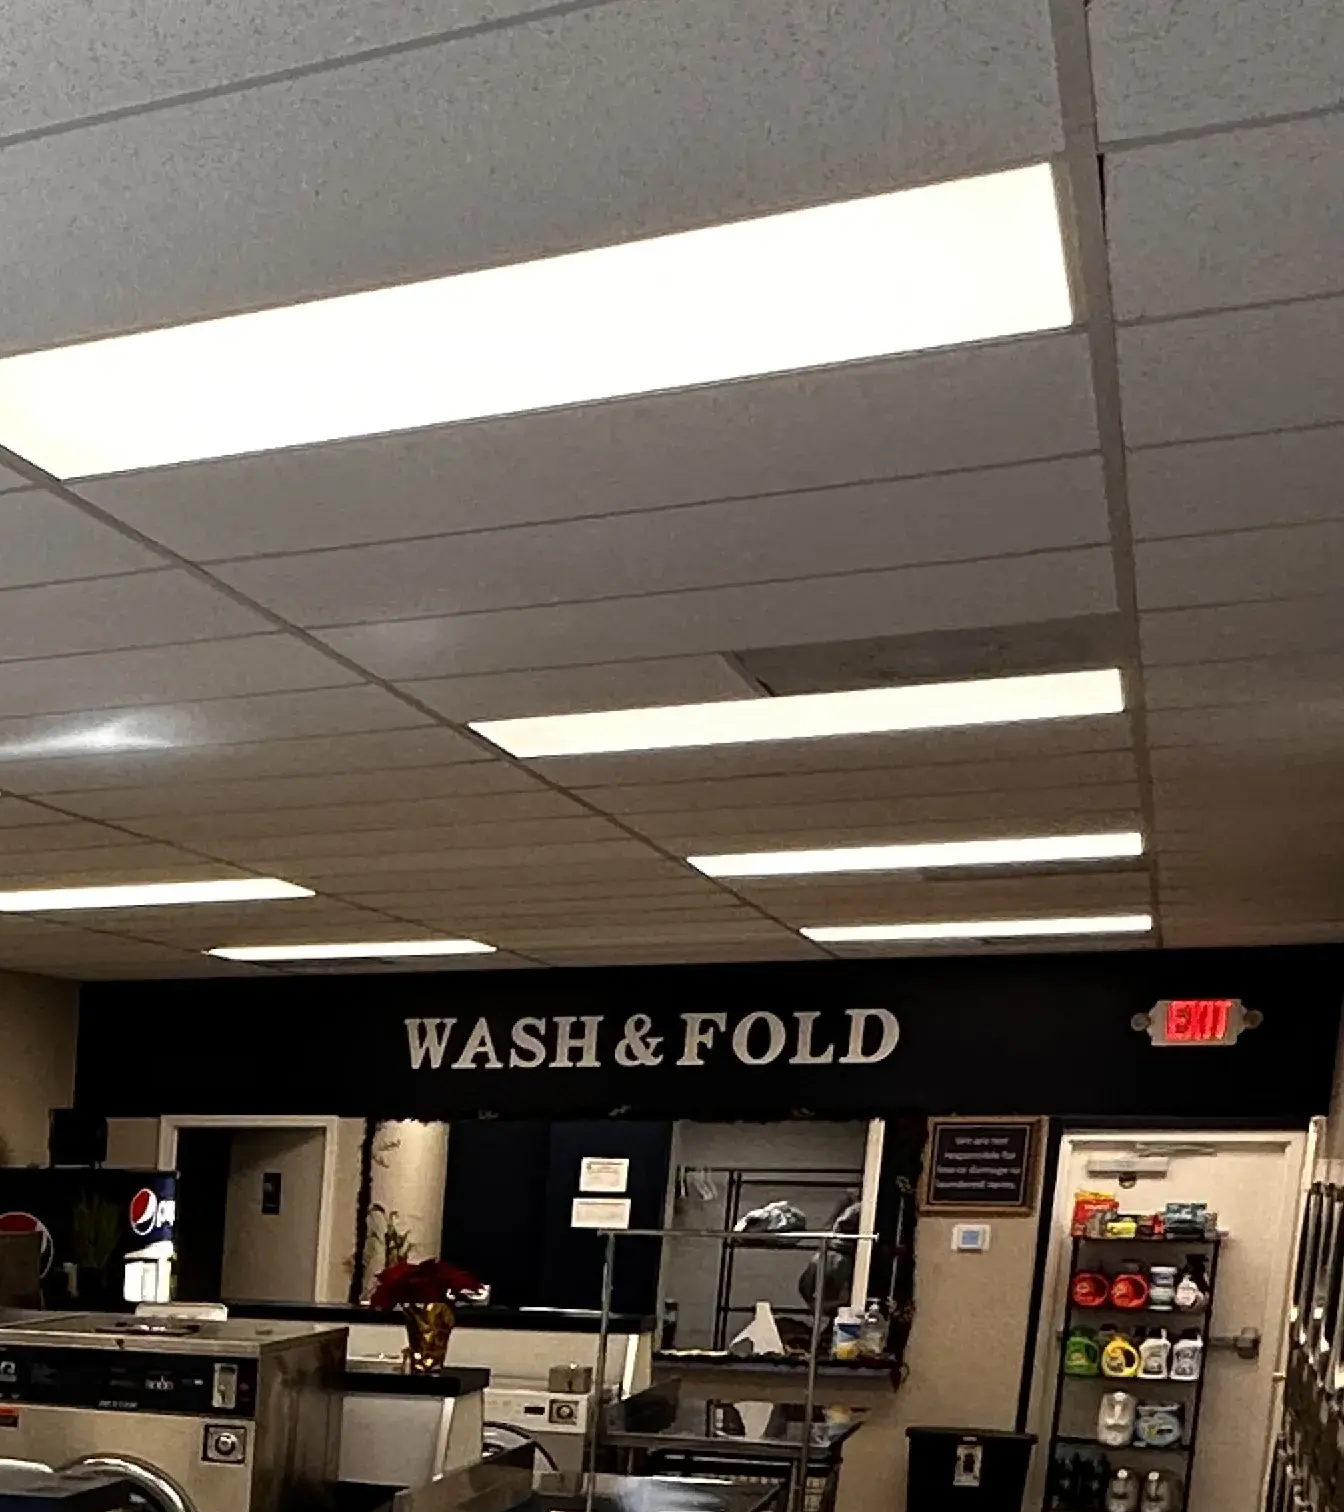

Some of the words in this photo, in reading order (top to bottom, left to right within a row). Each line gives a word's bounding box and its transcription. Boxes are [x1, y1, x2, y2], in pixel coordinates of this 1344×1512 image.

[404, 1016, 604, 1069] WASH
[676, 1008, 900, 1066] FOLD
[1169, 1000, 1231, 1040] EXIT
